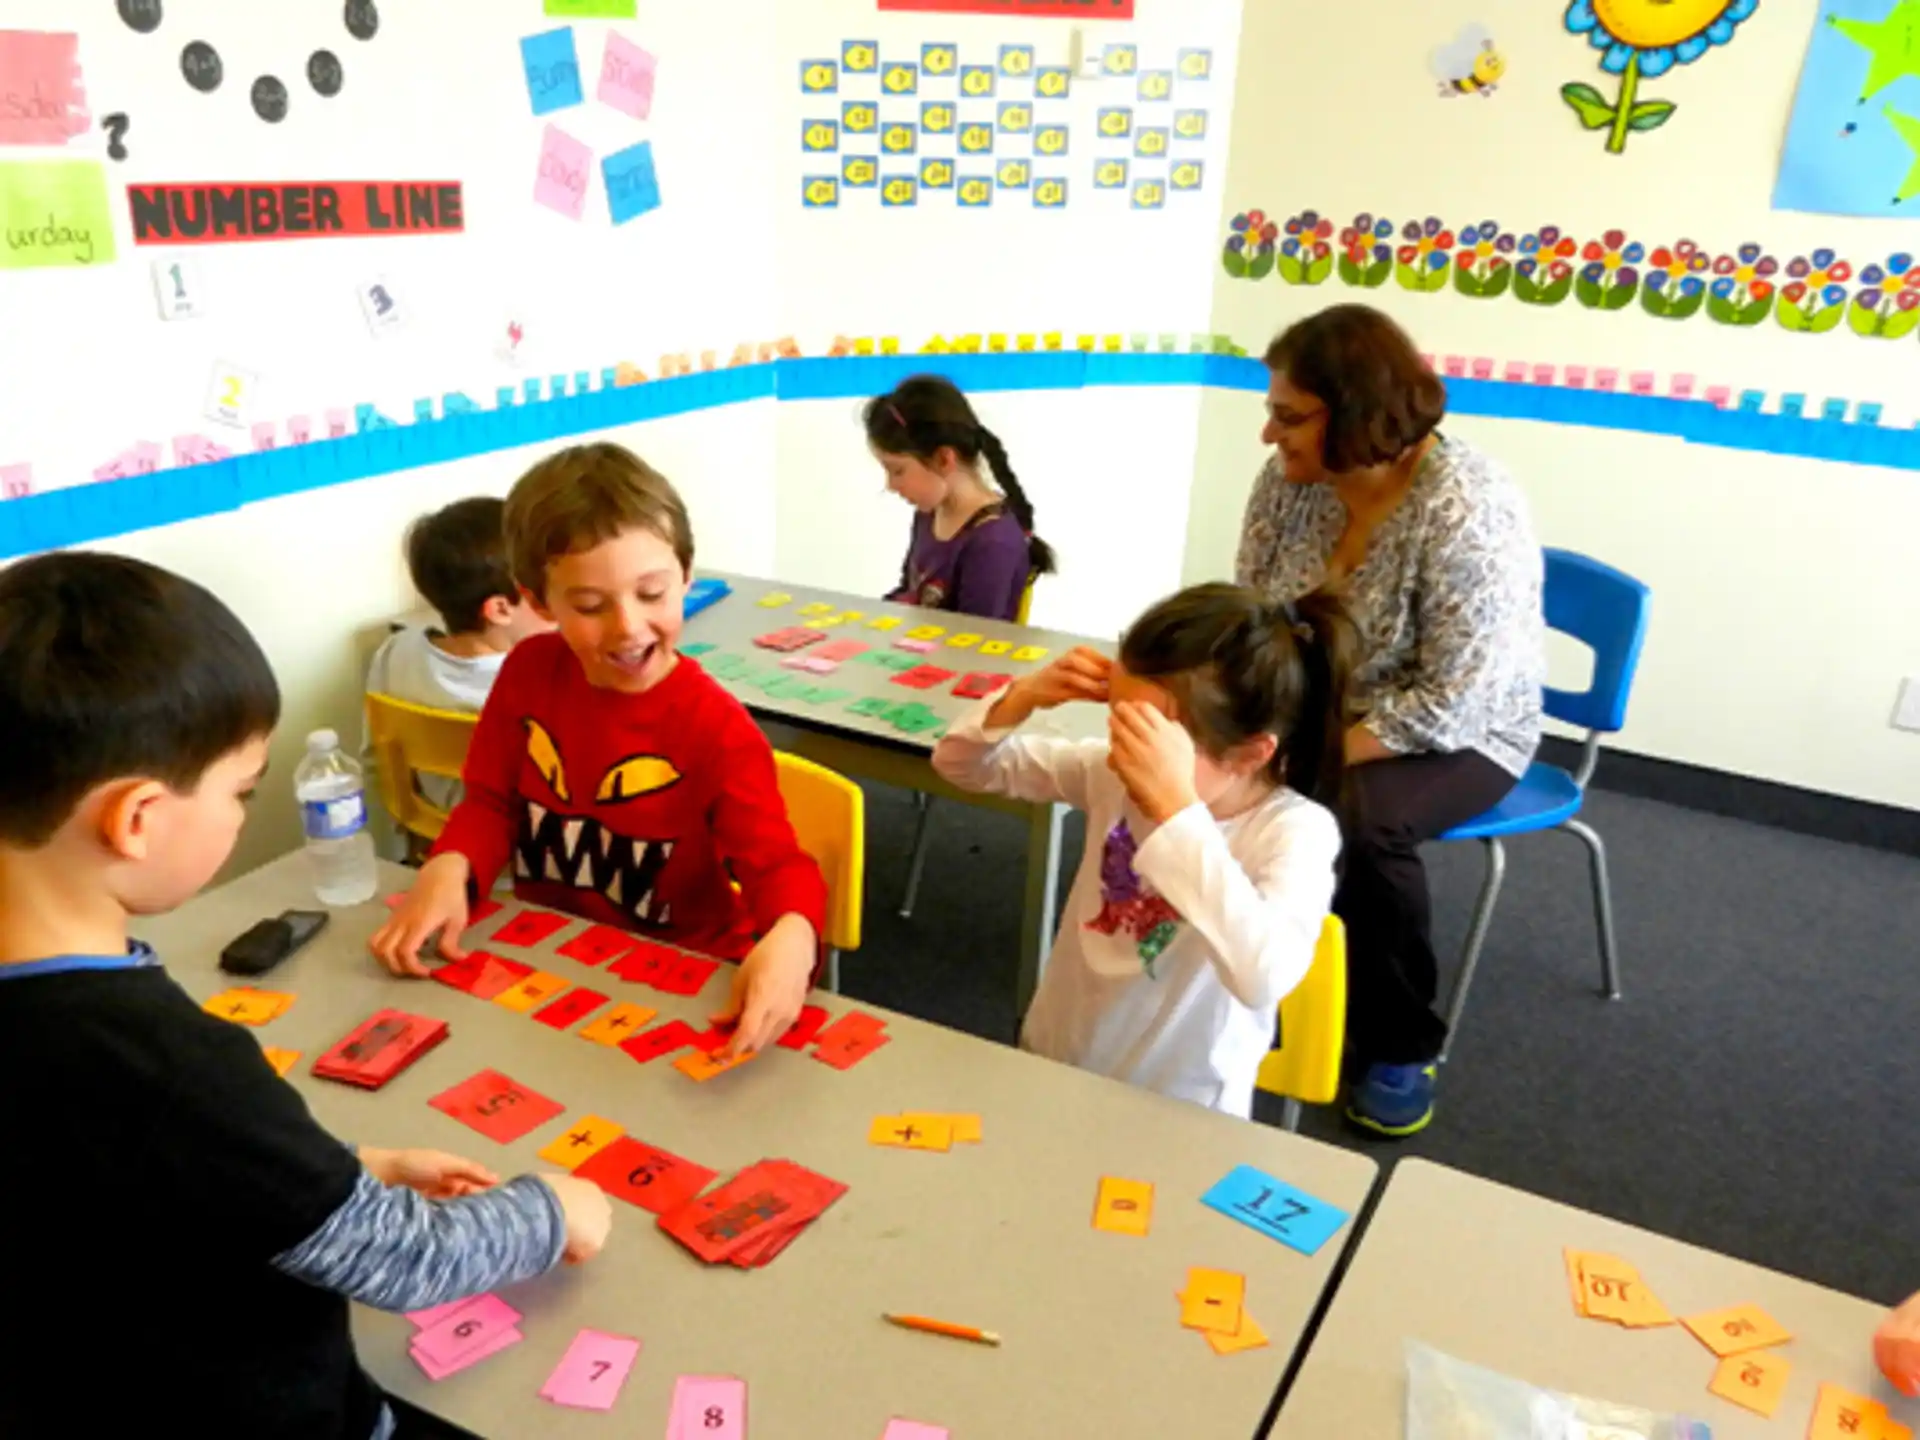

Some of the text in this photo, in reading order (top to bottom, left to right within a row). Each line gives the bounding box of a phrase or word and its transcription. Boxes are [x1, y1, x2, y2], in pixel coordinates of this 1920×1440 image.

[130, 185, 464, 239] NUMBER LINE
[6, 211, 94, 264] urday
[219, 375, 243, 408] 2
[1243, 1186, 1311, 1227] 17
[590, 1360, 612, 1382] 7
[704, 1405, 724, 1430] 8
